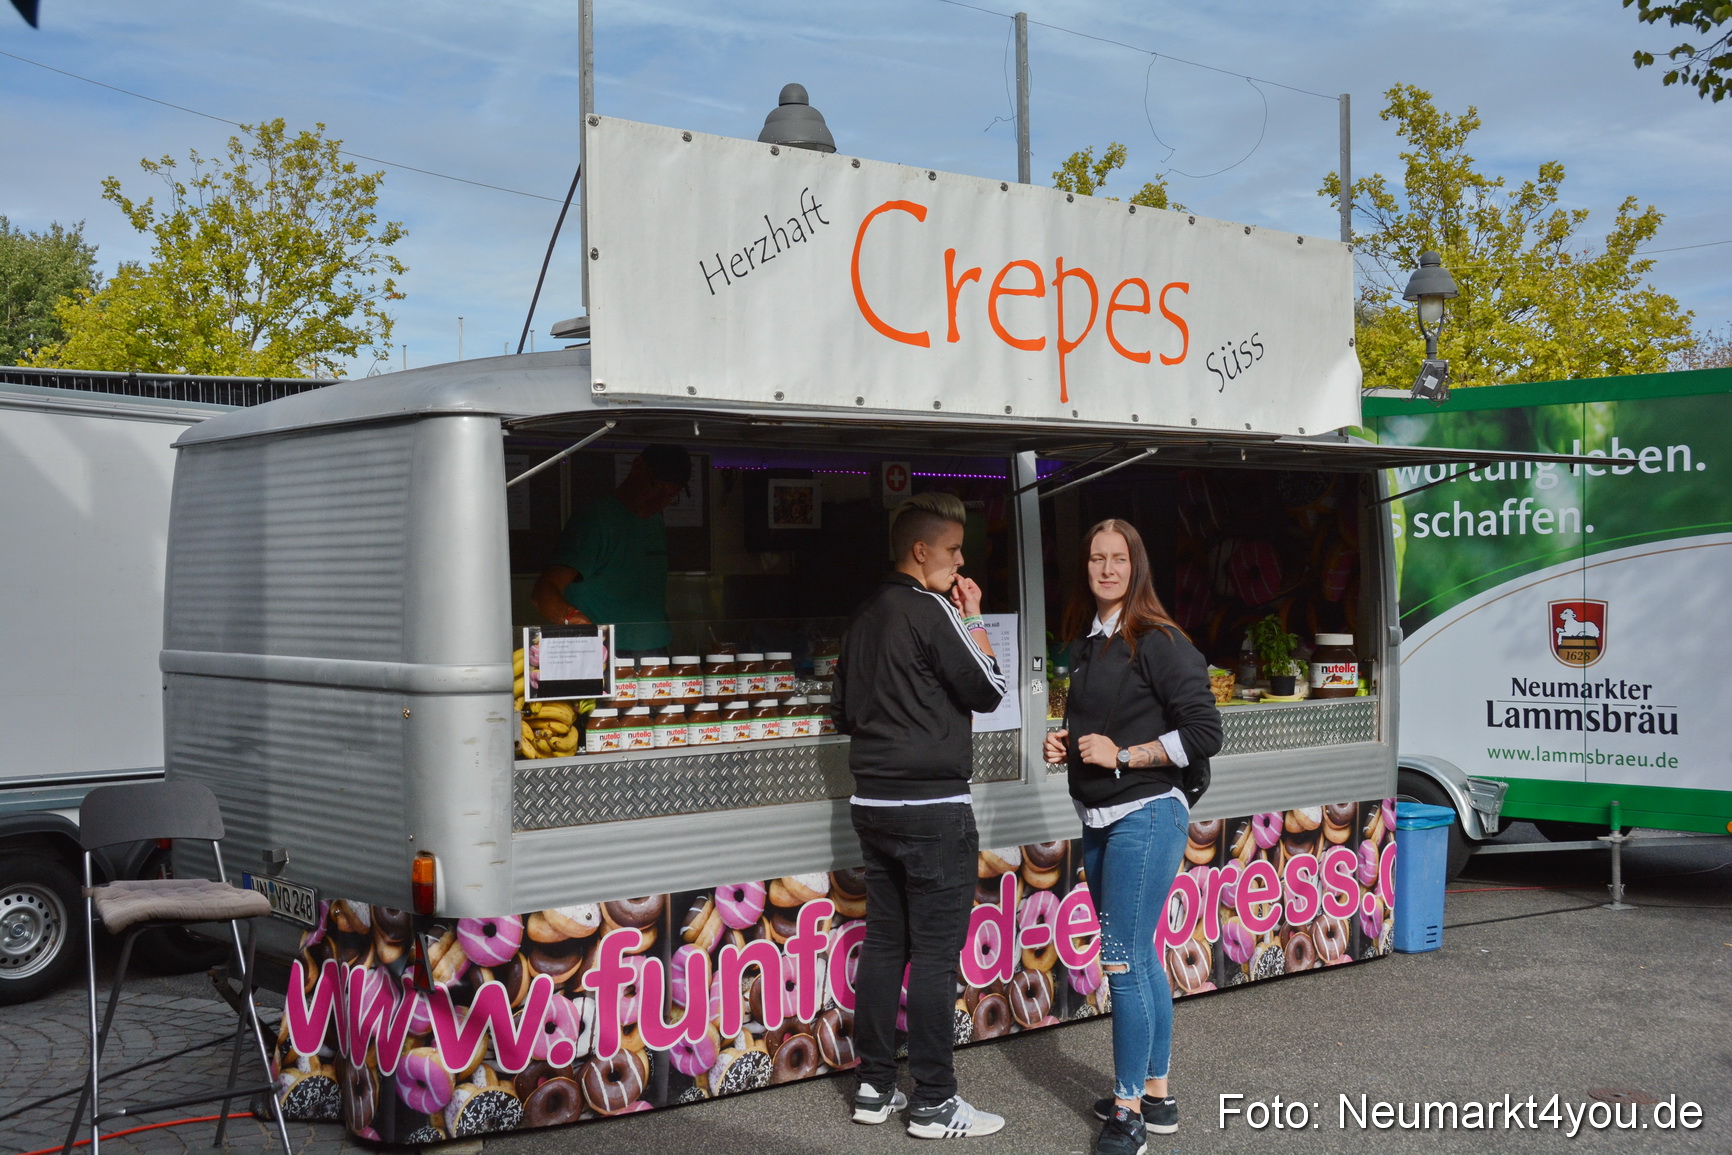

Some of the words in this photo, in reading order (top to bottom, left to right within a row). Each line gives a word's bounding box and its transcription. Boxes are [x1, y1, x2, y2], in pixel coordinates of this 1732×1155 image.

[699, 187, 829, 295] Herzhaft
[850, 200, 1190, 404] Crepes
[1206, 332, 1264, 393] Süss
[1413, 497, 1595, 539] schaffen.
[1321, 662, 1356, 674] nutella
[1566, 651, 1591, 661] 1628
[1511, 677, 1653, 701] Neumarkter
[698, 725, 721, 734] nutella
[1486, 700, 1679, 736] Lammsbräu
[628, 730, 652, 739] nutella
[1487, 745, 1679, 769] www.lammsbraeu.de
[293, 889, 313, 920] 248
